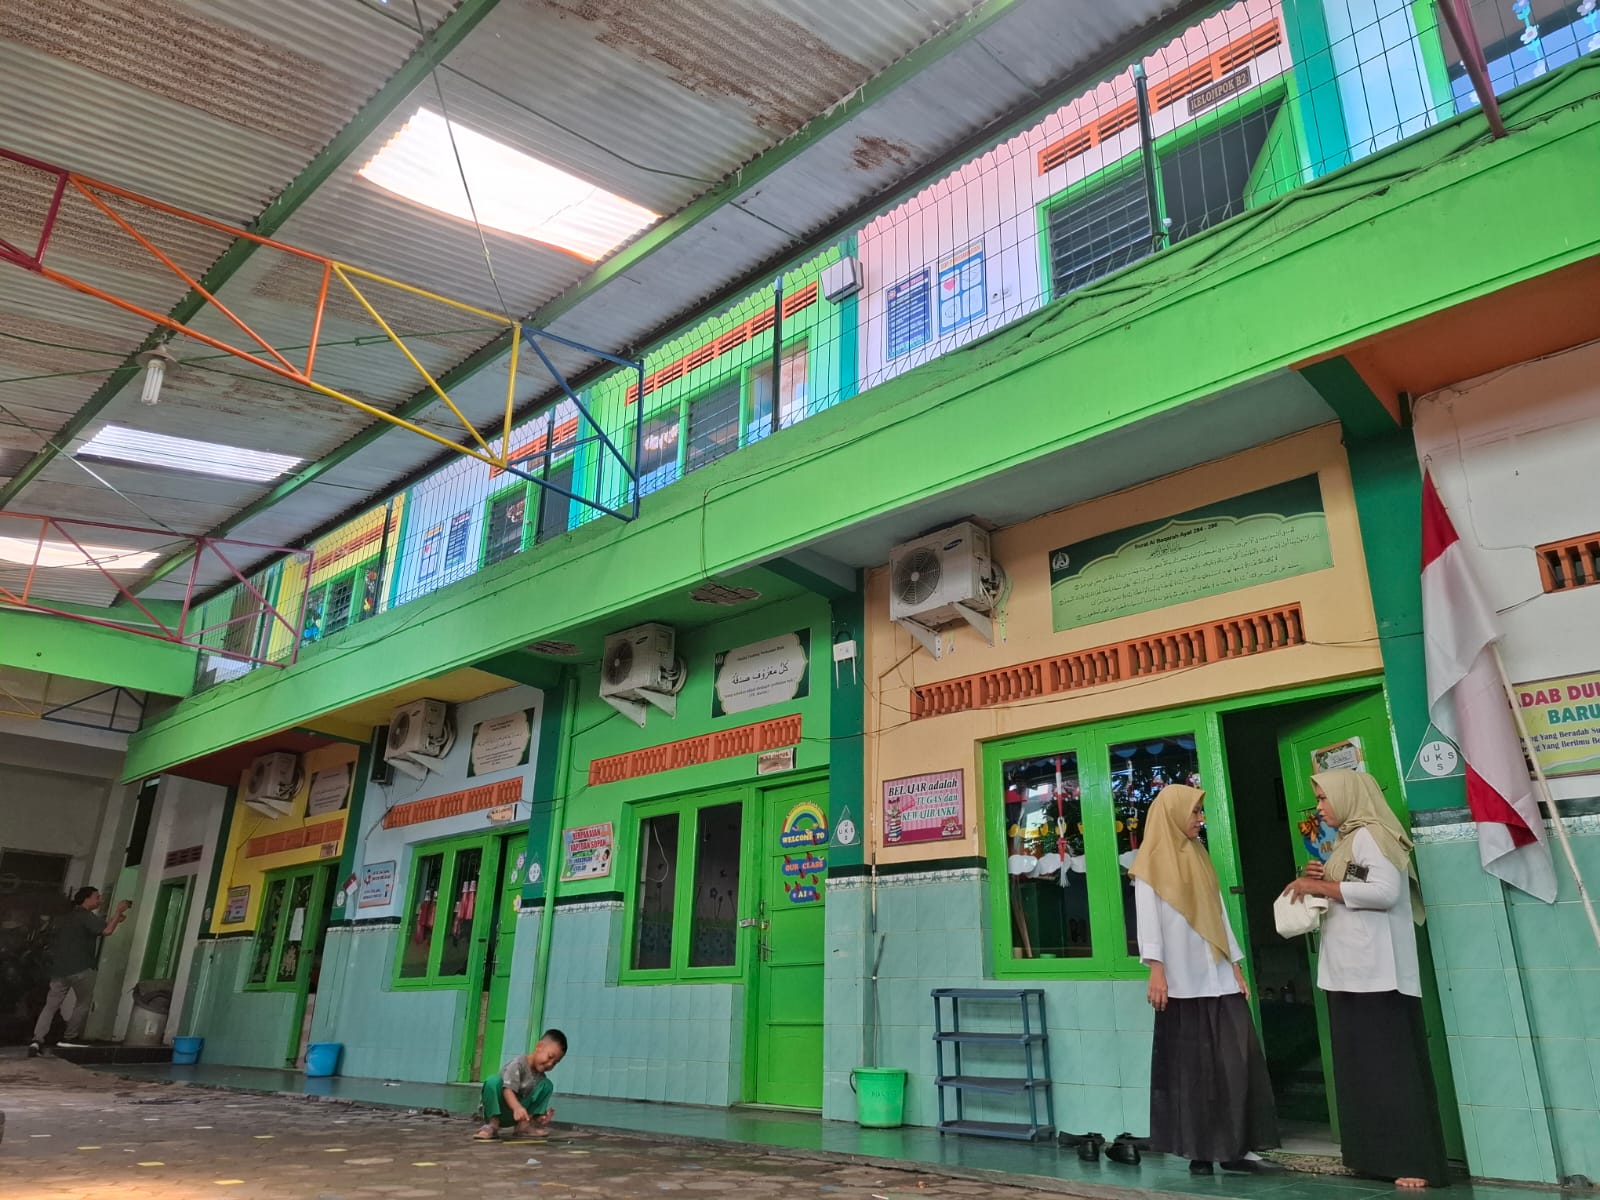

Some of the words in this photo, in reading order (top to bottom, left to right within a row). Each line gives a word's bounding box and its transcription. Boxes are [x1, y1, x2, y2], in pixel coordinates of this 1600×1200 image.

[1191, 79, 1235, 110] KELOMPOK
[1236, 73, 1246, 86] B2
[1509, 688, 1562, 710] DAB
[1547, 703, 1600, 725] BARU
[888, 782, 927, 797] BELAJAR
[928, 778, 958, 791] adalah
[916, 795, 942, 806] TUGAS
[943, 793, 958, 803] dan
[782, 831, 814, 843] WELCOME
[816, 832, 825, 840] TO
